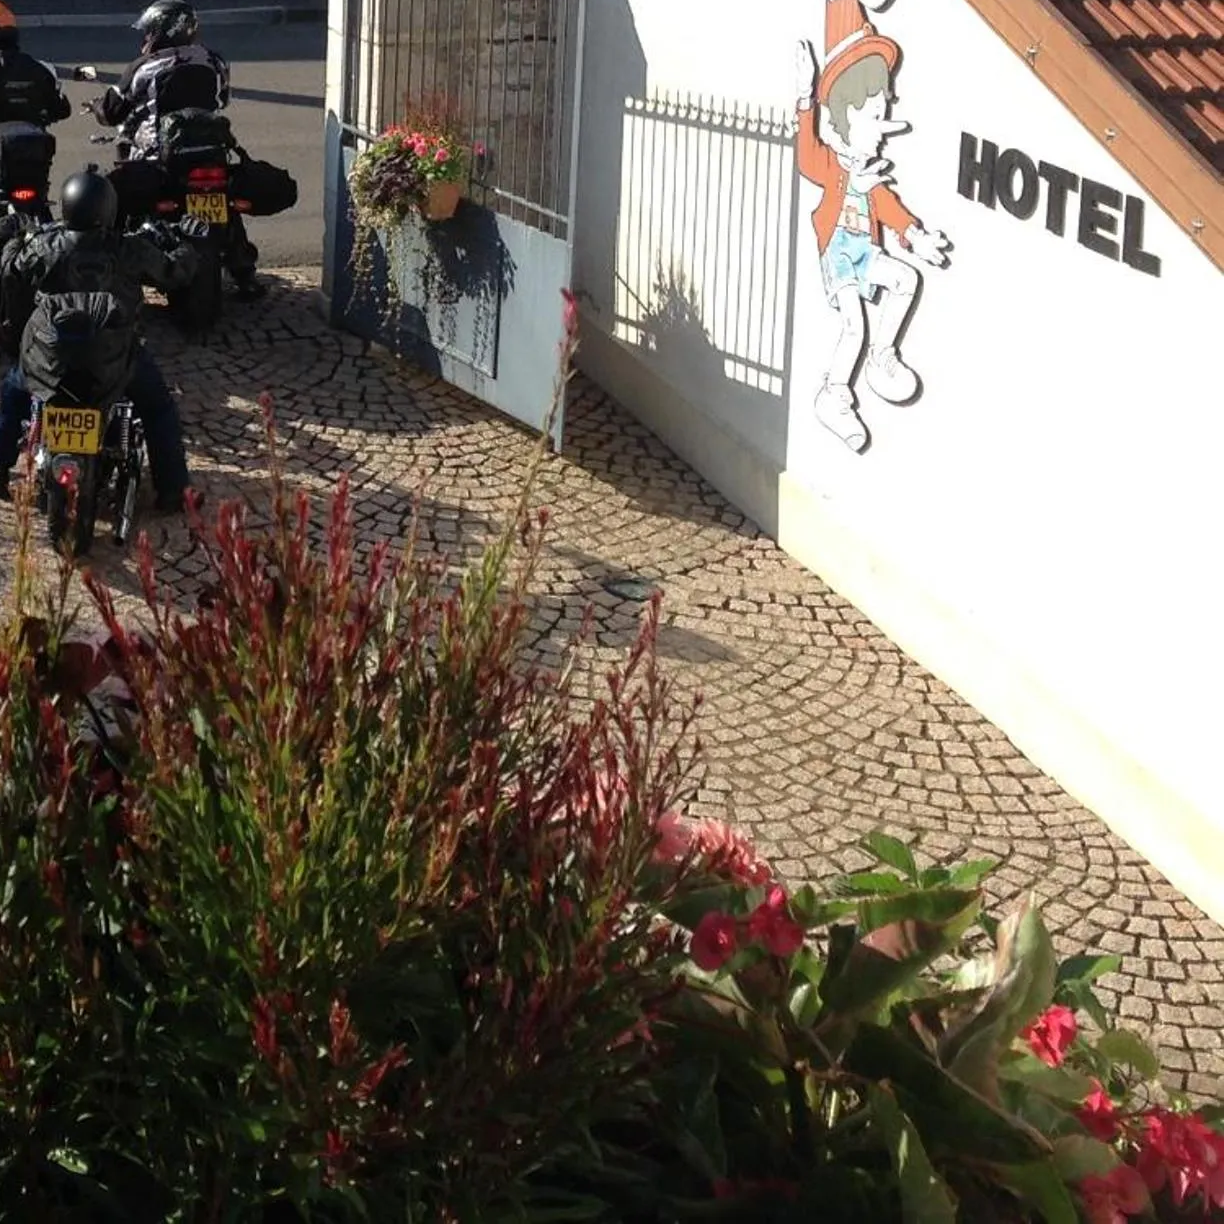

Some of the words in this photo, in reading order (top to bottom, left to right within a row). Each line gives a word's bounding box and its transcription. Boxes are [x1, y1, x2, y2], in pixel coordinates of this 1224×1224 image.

[957, 131, 1161, 278] HOTEL
[47, 412, 95, 429] WM08
[53, 430, 89, 448] YTT
